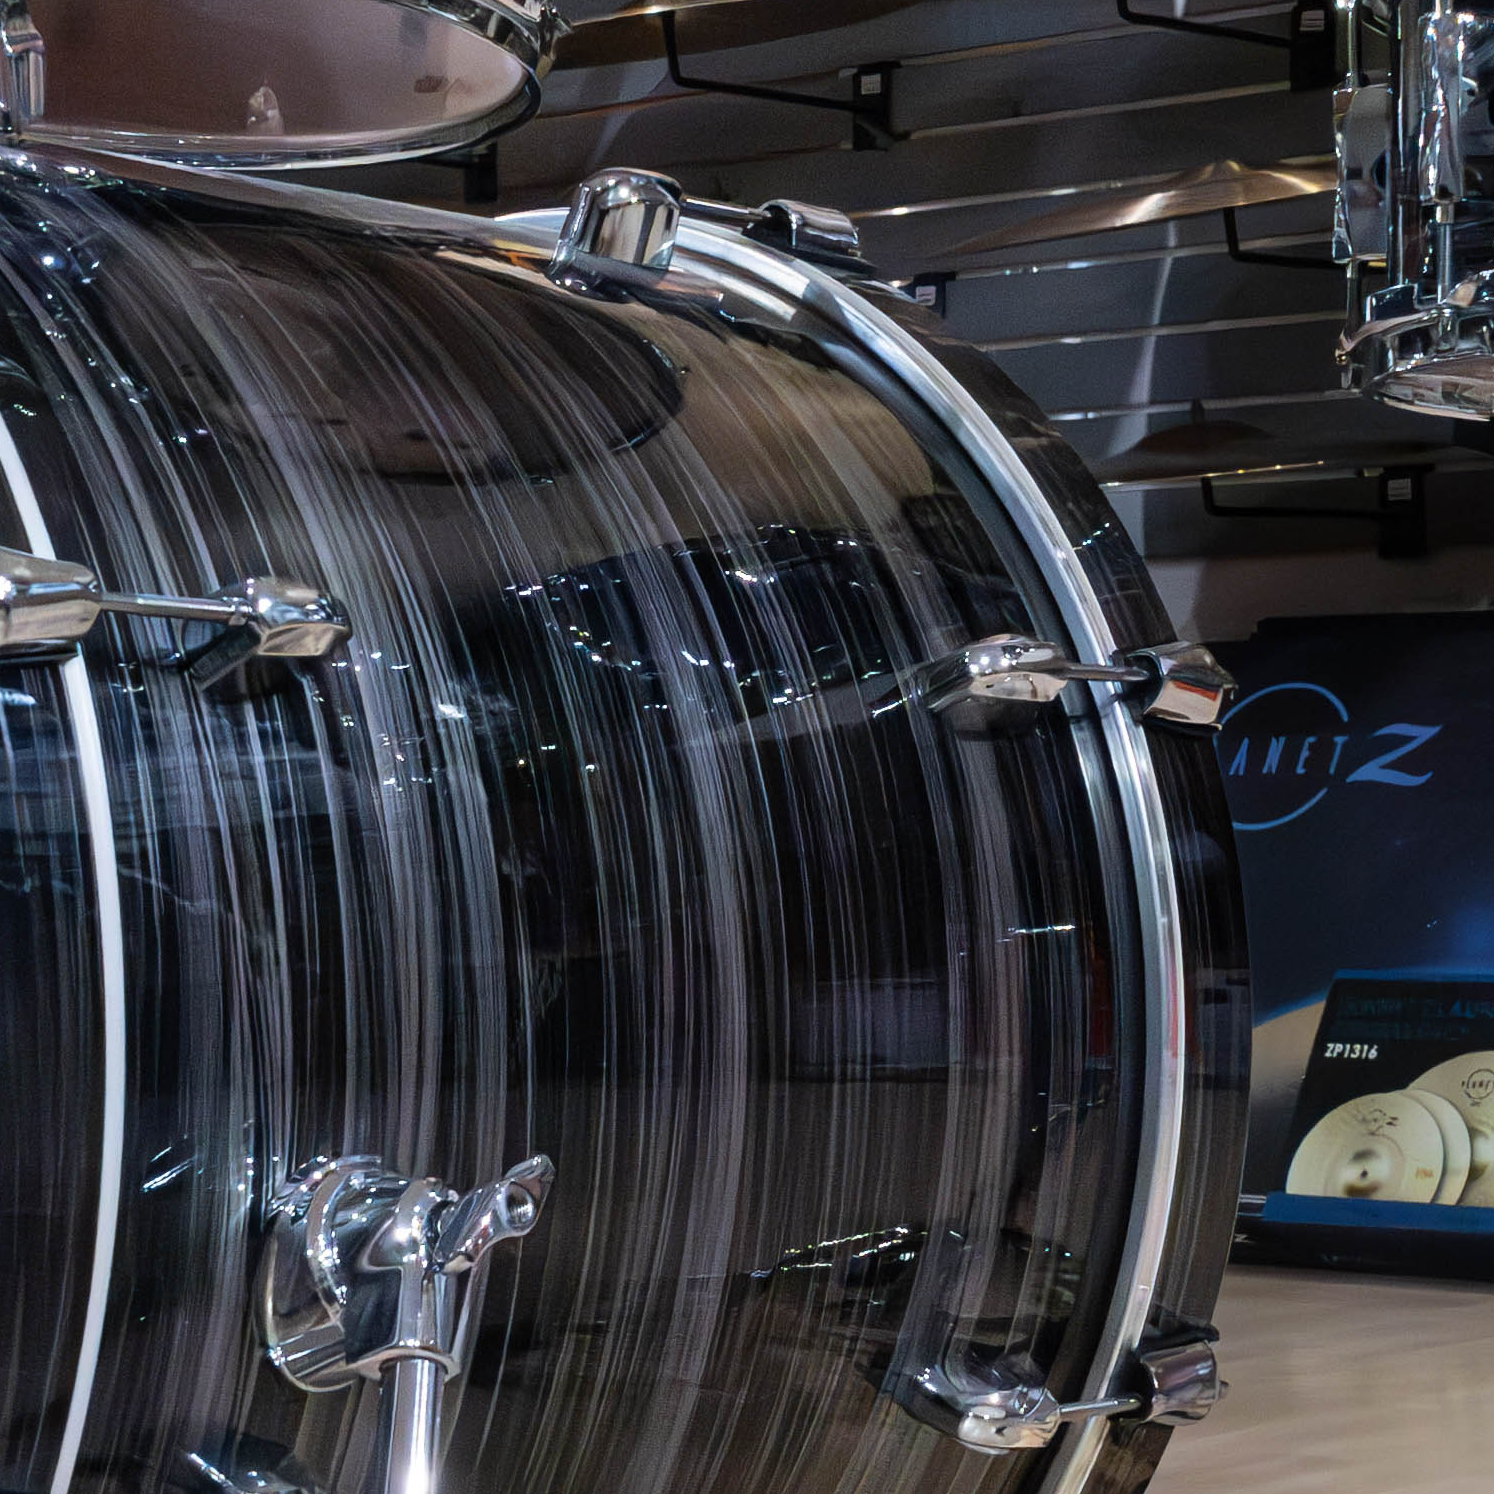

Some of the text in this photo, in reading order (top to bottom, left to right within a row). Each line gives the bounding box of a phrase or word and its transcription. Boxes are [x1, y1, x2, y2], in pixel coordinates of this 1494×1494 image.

[1228, 723, 1444, 787] ANET Z
[1324, 1043, 1379, 1059] ZP1316
